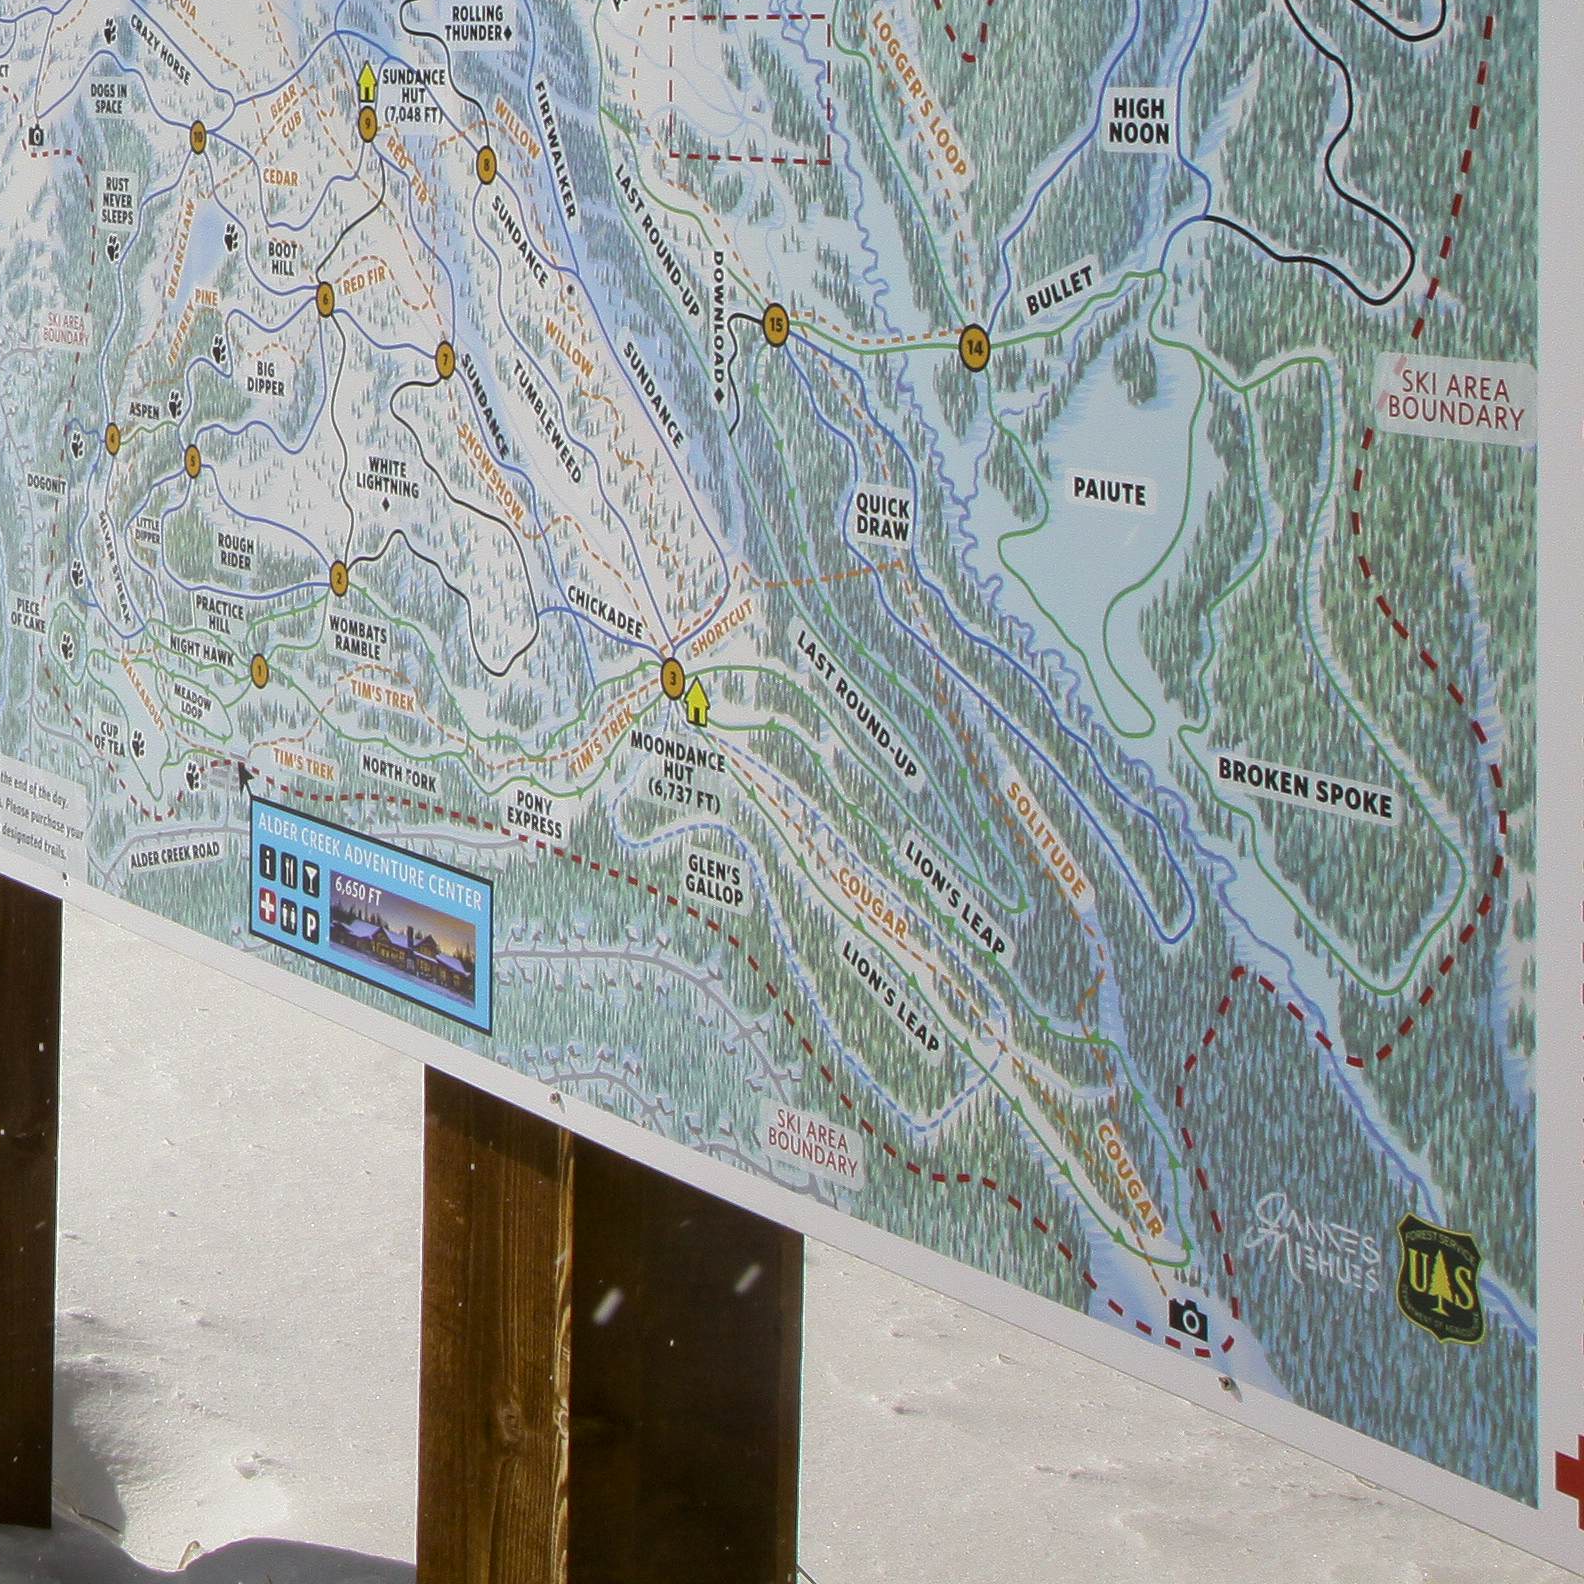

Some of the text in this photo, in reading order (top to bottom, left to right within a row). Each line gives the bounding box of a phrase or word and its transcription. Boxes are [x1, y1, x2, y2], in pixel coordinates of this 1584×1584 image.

[452, 5, 503, 22] ROLLING
[445, 25, 504, 41] THUNDER
[382, 69, 445, 85] SUNDANCE
[401, 88, 425, 103] HUT
[872, 11, 969, 179] LOGGER'S LOOP
[1113, 97, 1165, 120] HIGH
[535, 80, 577, 218] FIREWALKER
[1109, 121, 1170, 145] NOON
[268, 241, 298, 258] BOOT
[490, 194, 550, 290] SUNDANCE
[614, 165, 701, 318] LAST ROUND-UP
[1025, 265, 1096, 316] BULLET
[712, 251, 724, 384] DOWNLOAD
[768, 317, 783, 333] 15
[544, 319, 594, 379] WILLOW
[966, 338, 985, 358] 14
[257, 361, 276, 377] BIG
[1402, 368, 1509, 403] SKI AREA
[247, 376, 285, 396] DIPPER
[623, 342, 684, 450] SUNDANCE
[461, 353, 510, 460] SUNDANCE
[513, 359, 582, 484] TUMBLEWEED
[1387, 395, 1526, 431] BOUNDARY
[368, 456, 407, 477] WHITE
[356, 474, 420, 499] LIGHTNING
[1073, 474, 1147, 507] PAIUTE
[856, 492, 910, 518] QUICK
[218, 532, 254, 555] ROUGH
[856, 514, 909, 542] DRAW
[220, 549, 252, 571] RIDER
[196, 594, 245, 621] PRACTICE
[566, 584, 644, 641] CHICKADEE
[208, 615, 231, 634] HILL
[330, 615, 387, 644] WOMBATS
[690, 598, 754, 657] SHORTCUT
[170, 636, 234, 666] NIGHT HAWK
[335, 634, 381, 661] RAMBLE
[350, 678, 415, 713] TIM'S TREK
[669, 672, 677, 686] 3
[796, 630, 919, 780] LAST ROUND-UP
[631, 730, 726, 774] MOONDANCE
[663, 760, 694, 783] HUT
[1219, 756, 1394, 819] BROKEN SPOKE
[516, 789, 553, 816] PONY
[507, 805, 563, 839] EXPRESS
[131, 842, 220, 868] ALDER CREEK ROAD
[1006, 781, 1087, 899] SOLITUDE
[258, 813, 482, 912] ALDER CREEK ADVENTURE CENTER
[687, 852, 741, 884] GLEN'S
[685, 872, 744, 909] GALLOP
[838, 866, 908, 941] COUGAR
[904, 839, 1006, 958] LION'S LEAP
[842, 941, 941, 1055] LION'S LEAP
[776, 1108, 849, 1151] SKI AREA
[767, 1125, 858, 1179] BOUNDARY
[1096, 1123, 1165, 1239] COUGAR
